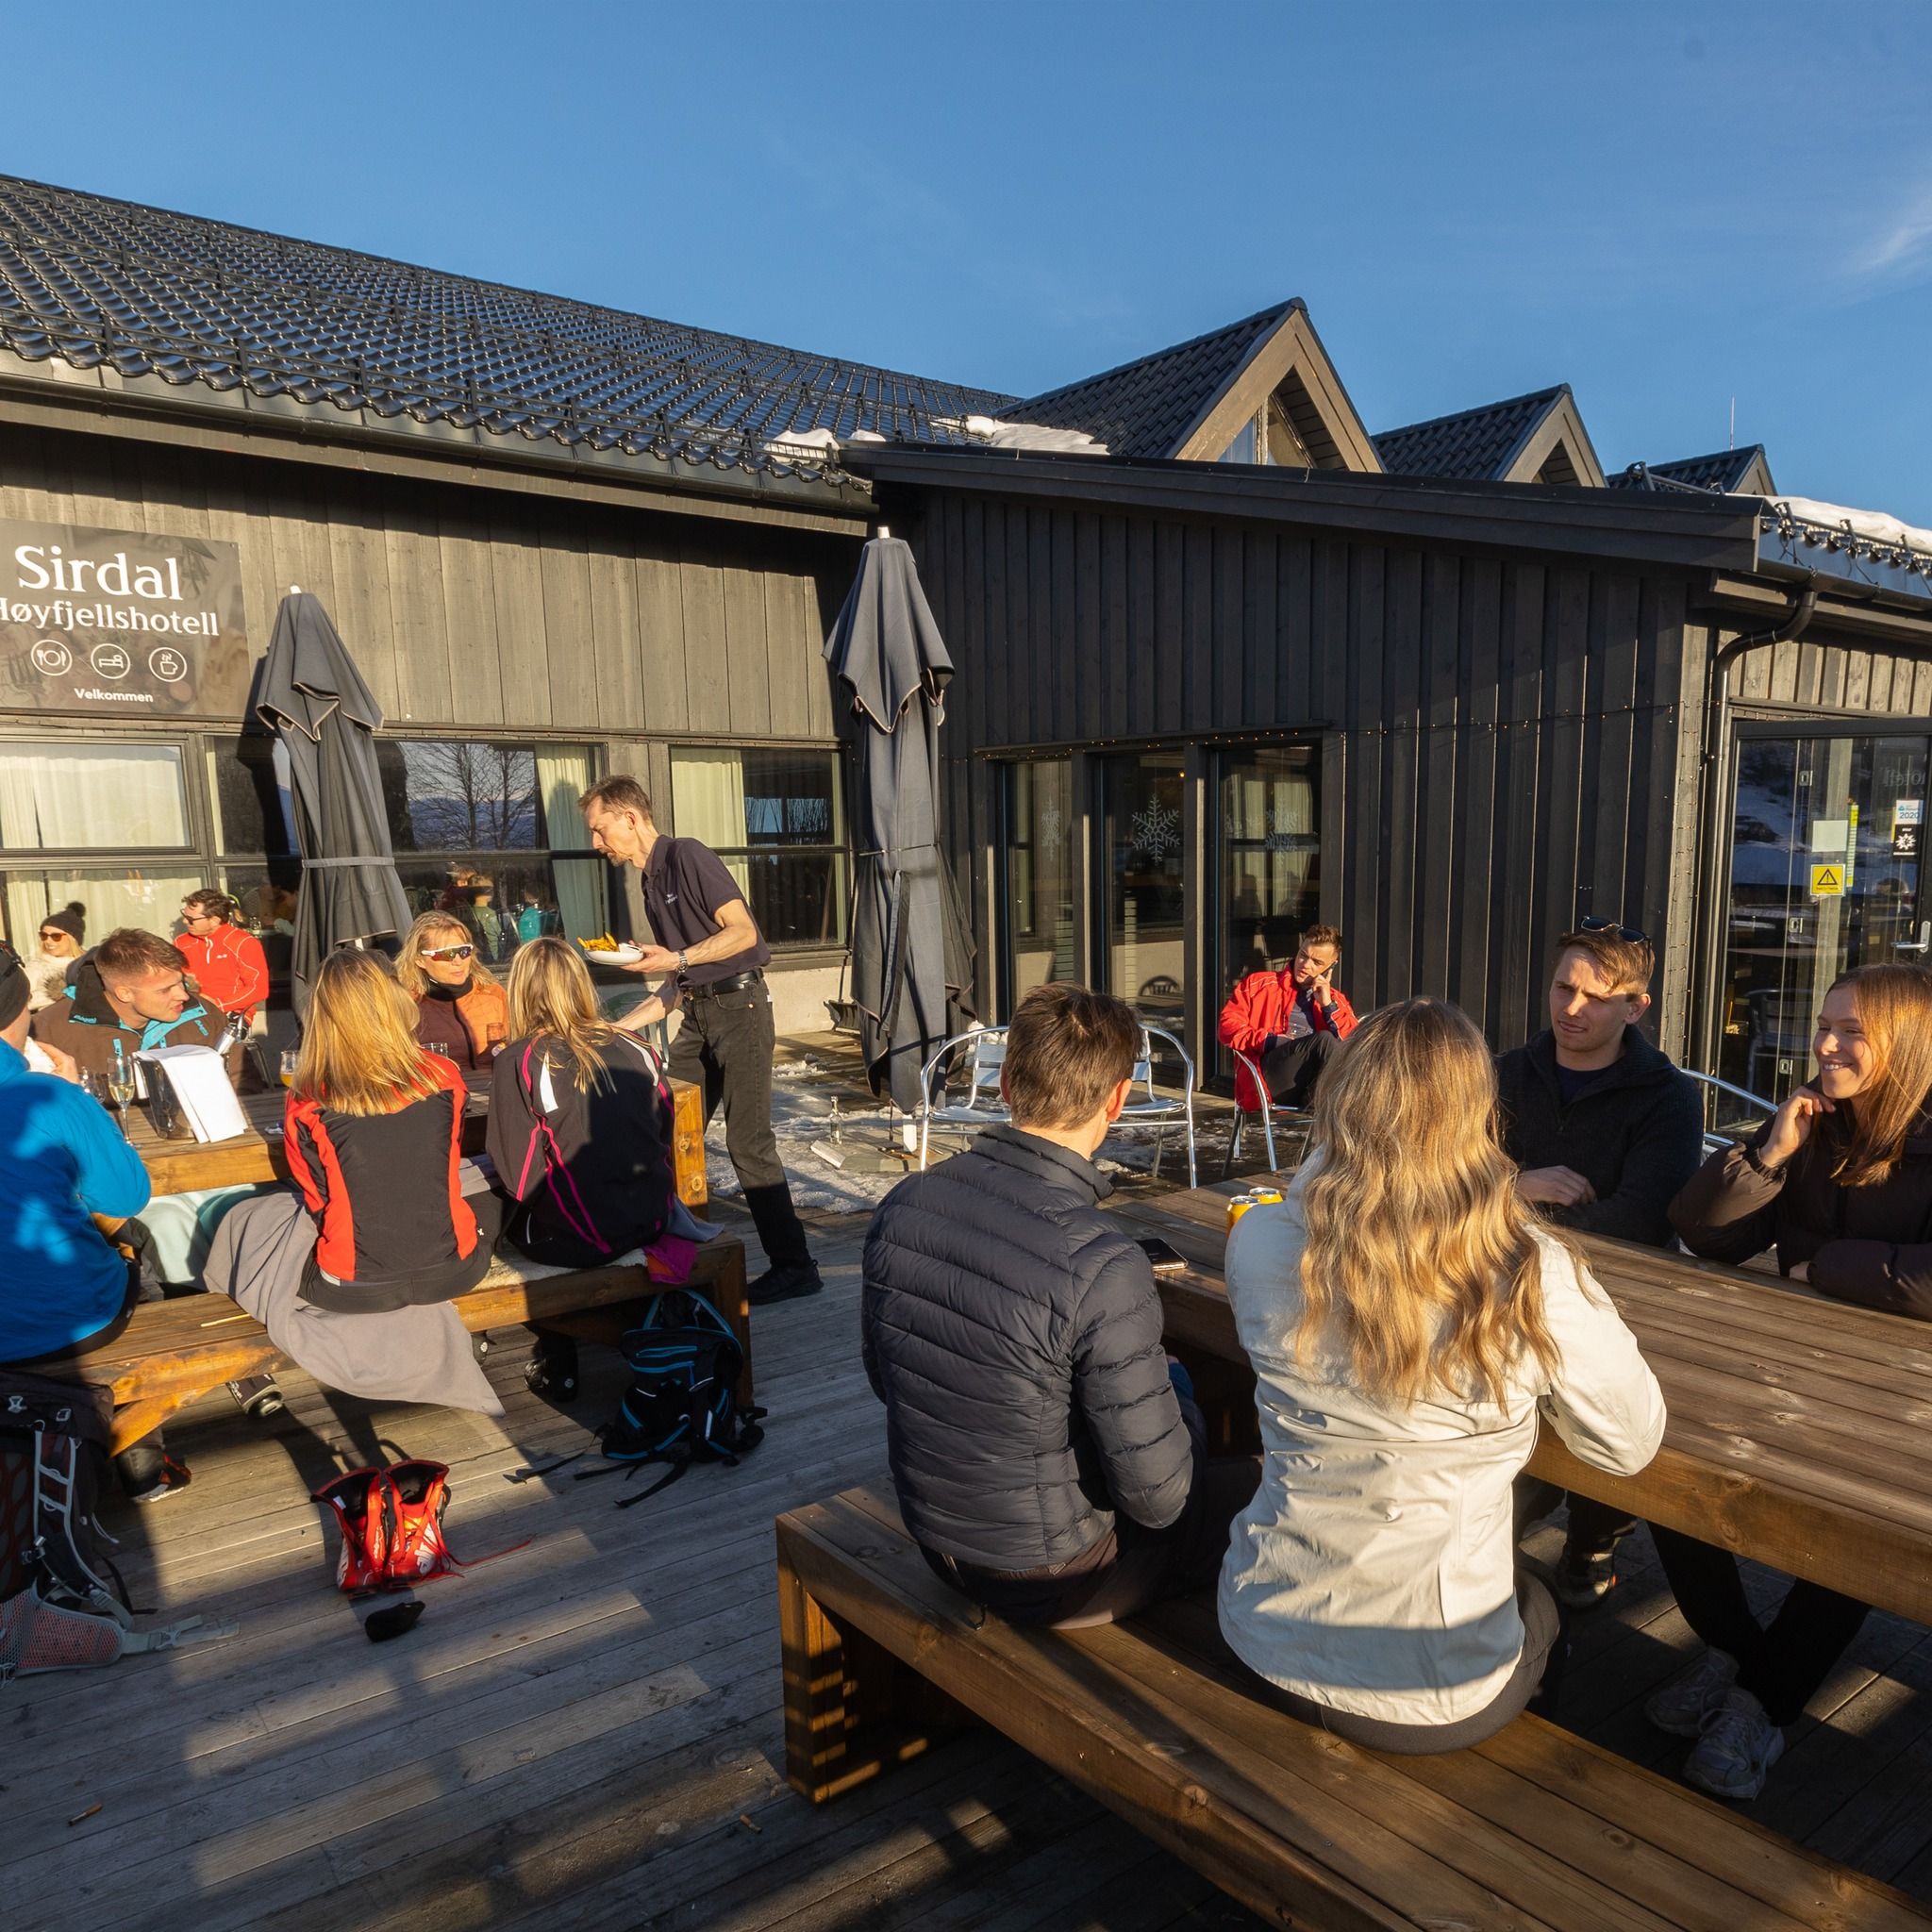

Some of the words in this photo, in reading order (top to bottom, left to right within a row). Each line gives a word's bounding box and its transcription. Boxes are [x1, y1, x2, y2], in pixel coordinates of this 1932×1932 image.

[14, 545, 184, 601] Sirdal
[74, 688, 154, 703] Velkommen
[1899, 811, 1921, 820] 2020
